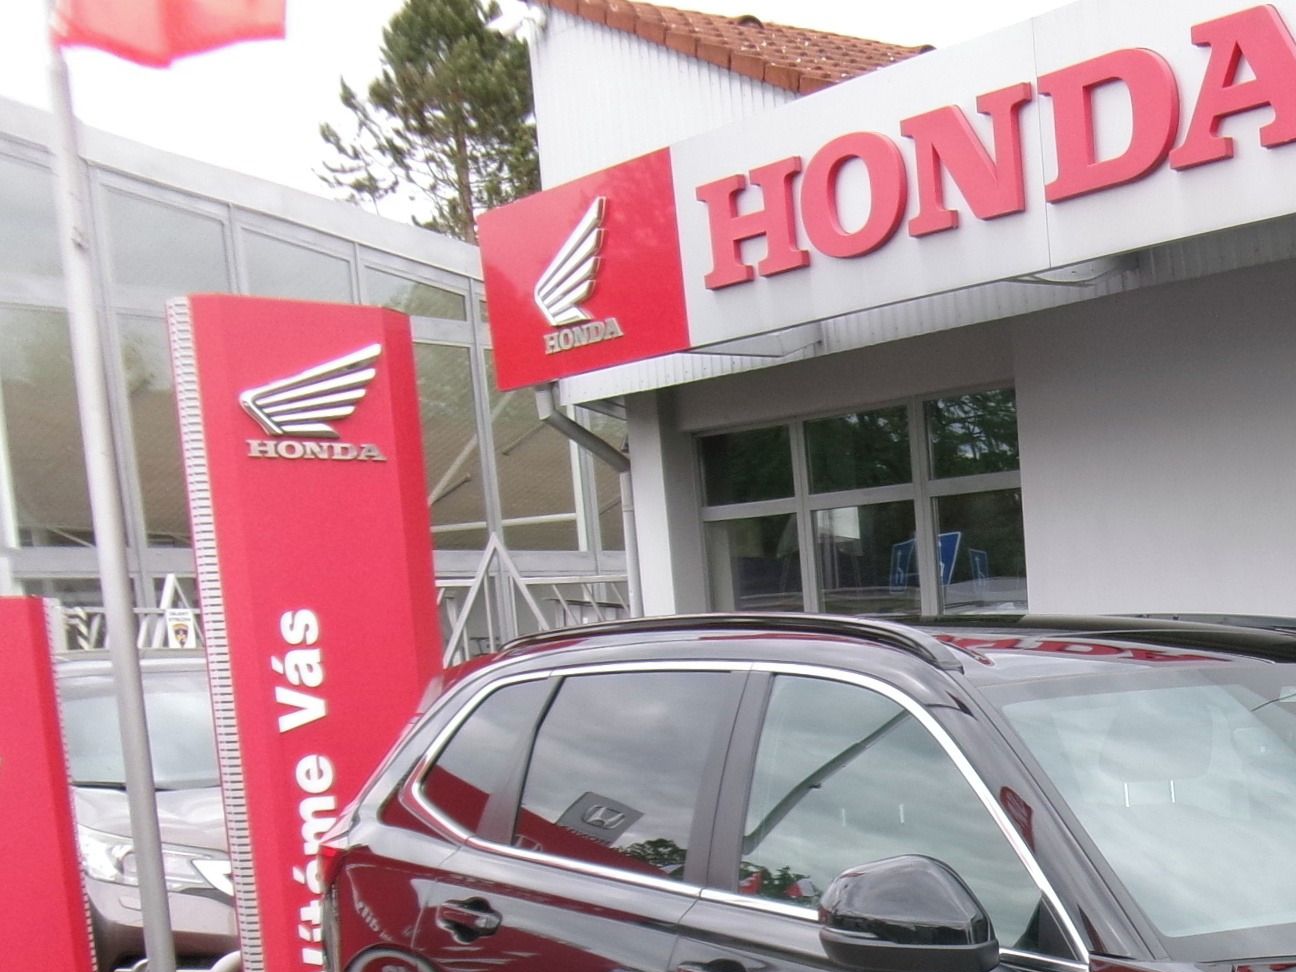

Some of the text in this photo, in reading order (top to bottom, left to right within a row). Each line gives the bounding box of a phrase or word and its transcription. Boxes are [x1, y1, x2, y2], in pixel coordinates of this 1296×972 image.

[544, 317, 624, 355] HONDA
[246, 438, 387, 462] HONDA
[271, 608, 327, 734] Vás
